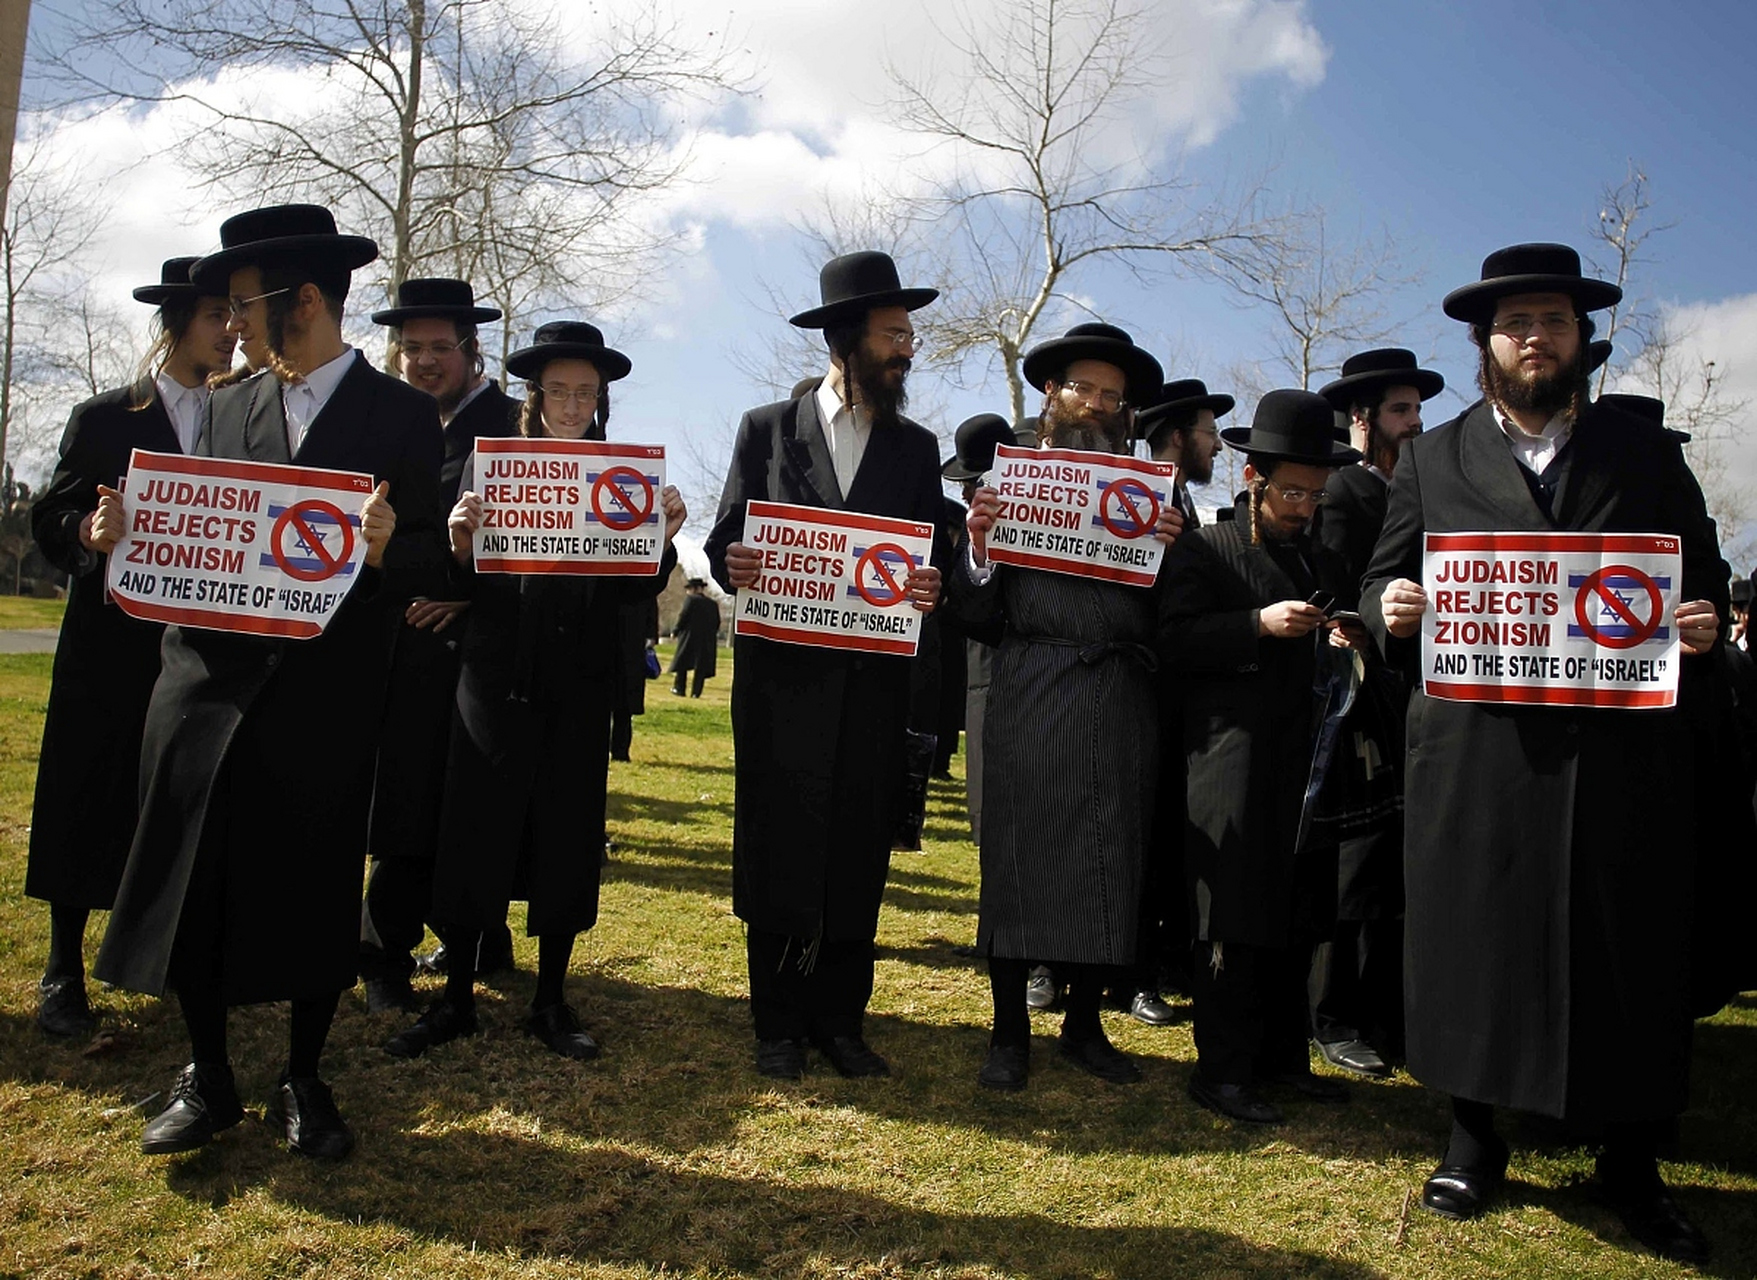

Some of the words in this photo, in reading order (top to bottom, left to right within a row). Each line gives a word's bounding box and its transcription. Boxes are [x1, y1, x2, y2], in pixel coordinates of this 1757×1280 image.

[484, 460, 579, 480] JUDAISM
[1001, 463, 1091, 485] JUDAISM
[138, 480, 261, 513] JUDAISM
[484, 485, 579, 505] REJECTS
[999, 482, 1089, 507] REJECTS
[133, 509, 256, 543] REJECTS
[482, 509, 573, 529] ZIONISM
[996, 501, 1081, 530] ZIONISM
[482, 535, 509, 552] AND
[512, 536, 538, 553] THE
[541, 536, 579, 554] STATE
[583, 538, 599, 555] OF
[753, 524, 847, 553] JUDAISM
[992, 525, 1017, 544] AND
[1021, 529, 1044, 549] THE
[1047, 533, 1084, 556] STATE
[1086, 540, 1101, 558] OF
[126, 540, 245, 574] ZIONISM
[1436, 560, 1558, 584] JUDAISM
[119, 570, 156, 595] AND
[161, 576, 193, 600] THE
[196, 579, 248, 606] STATE
[252, 585, 275, 609] OF
[1436, 590, 1559, 615] REJECTS
[745, 597, 769, 618] AND
[774, 603, 797, 622] THE
[800, 606, 839, 627] STATE
[841, 611, 858, 629] OF
[1434, 621, 1550, 647] ZIONISM
[1433, 653, 1467, 675] AND
[1472, 654, 1504, 676] THE
[1509, 655, 1560, 679] STATE
[1565, 657, 1587, 680] OF
